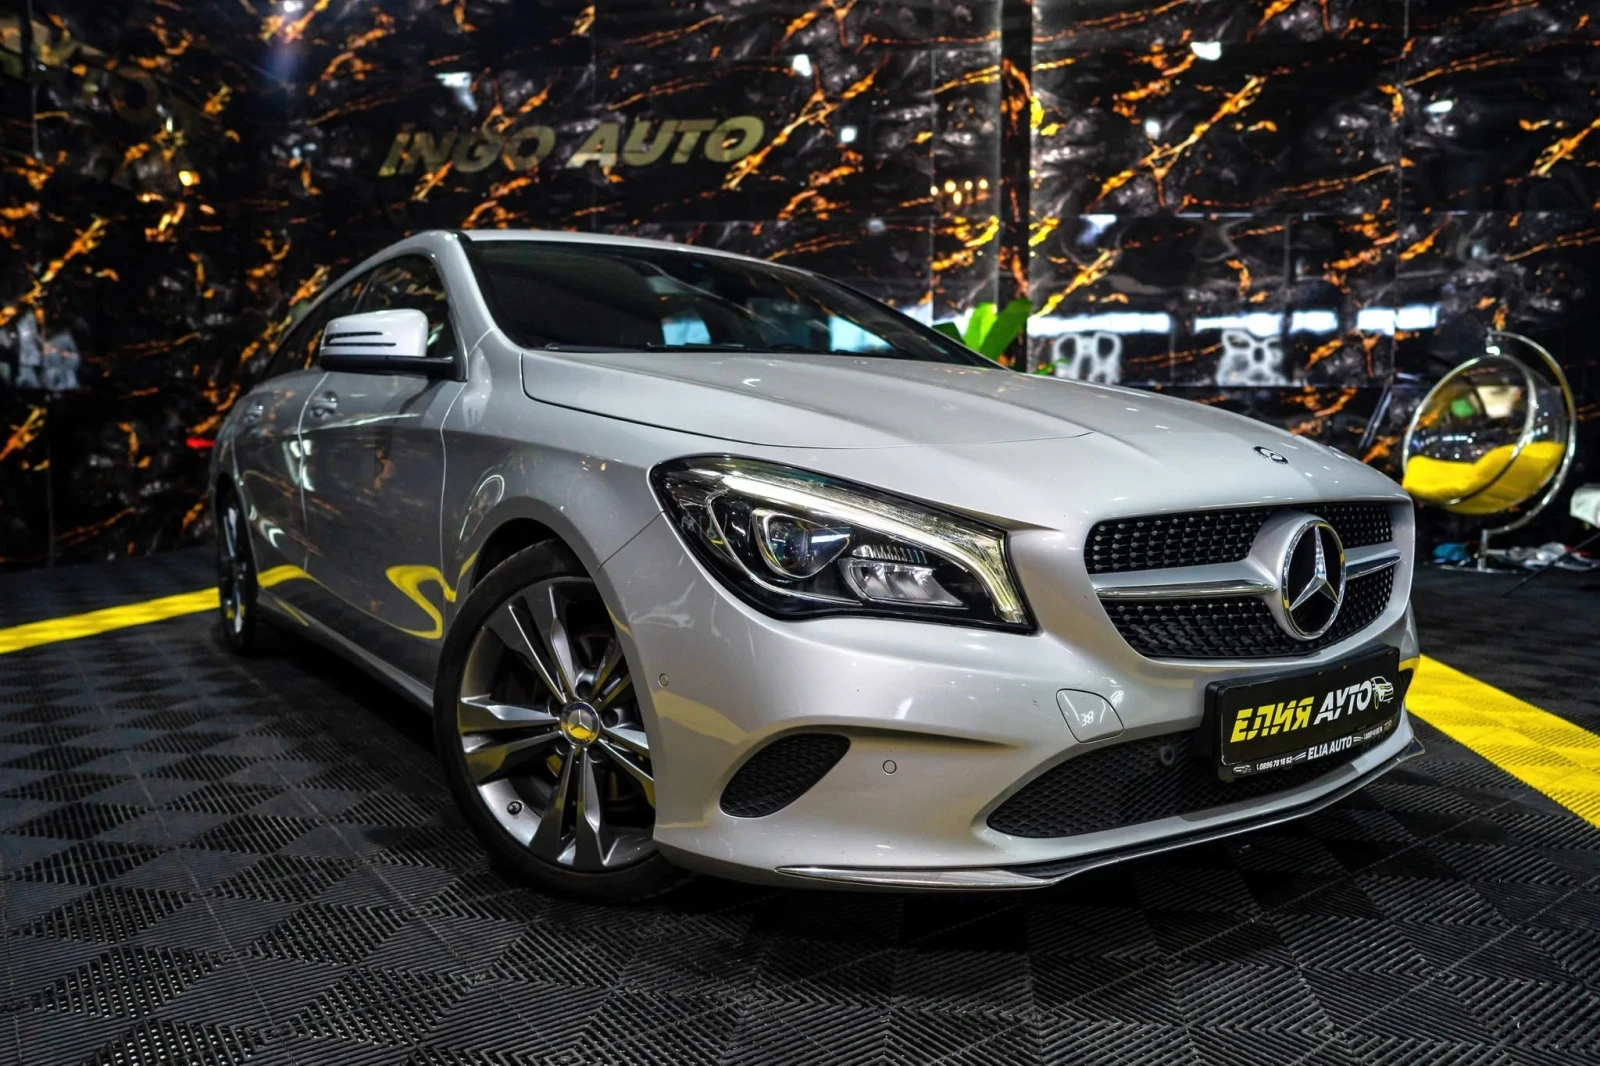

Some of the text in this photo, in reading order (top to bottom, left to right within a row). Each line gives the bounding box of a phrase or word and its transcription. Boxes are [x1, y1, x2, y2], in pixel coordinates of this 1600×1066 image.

[378, 116, 764, 177] INGO AUTO
[1230, 696, 1315, 743] ЕЛИЯ
[1307, 743, 1328, 760] ELIA
[1329, 735, 1352, 754] AUTO
